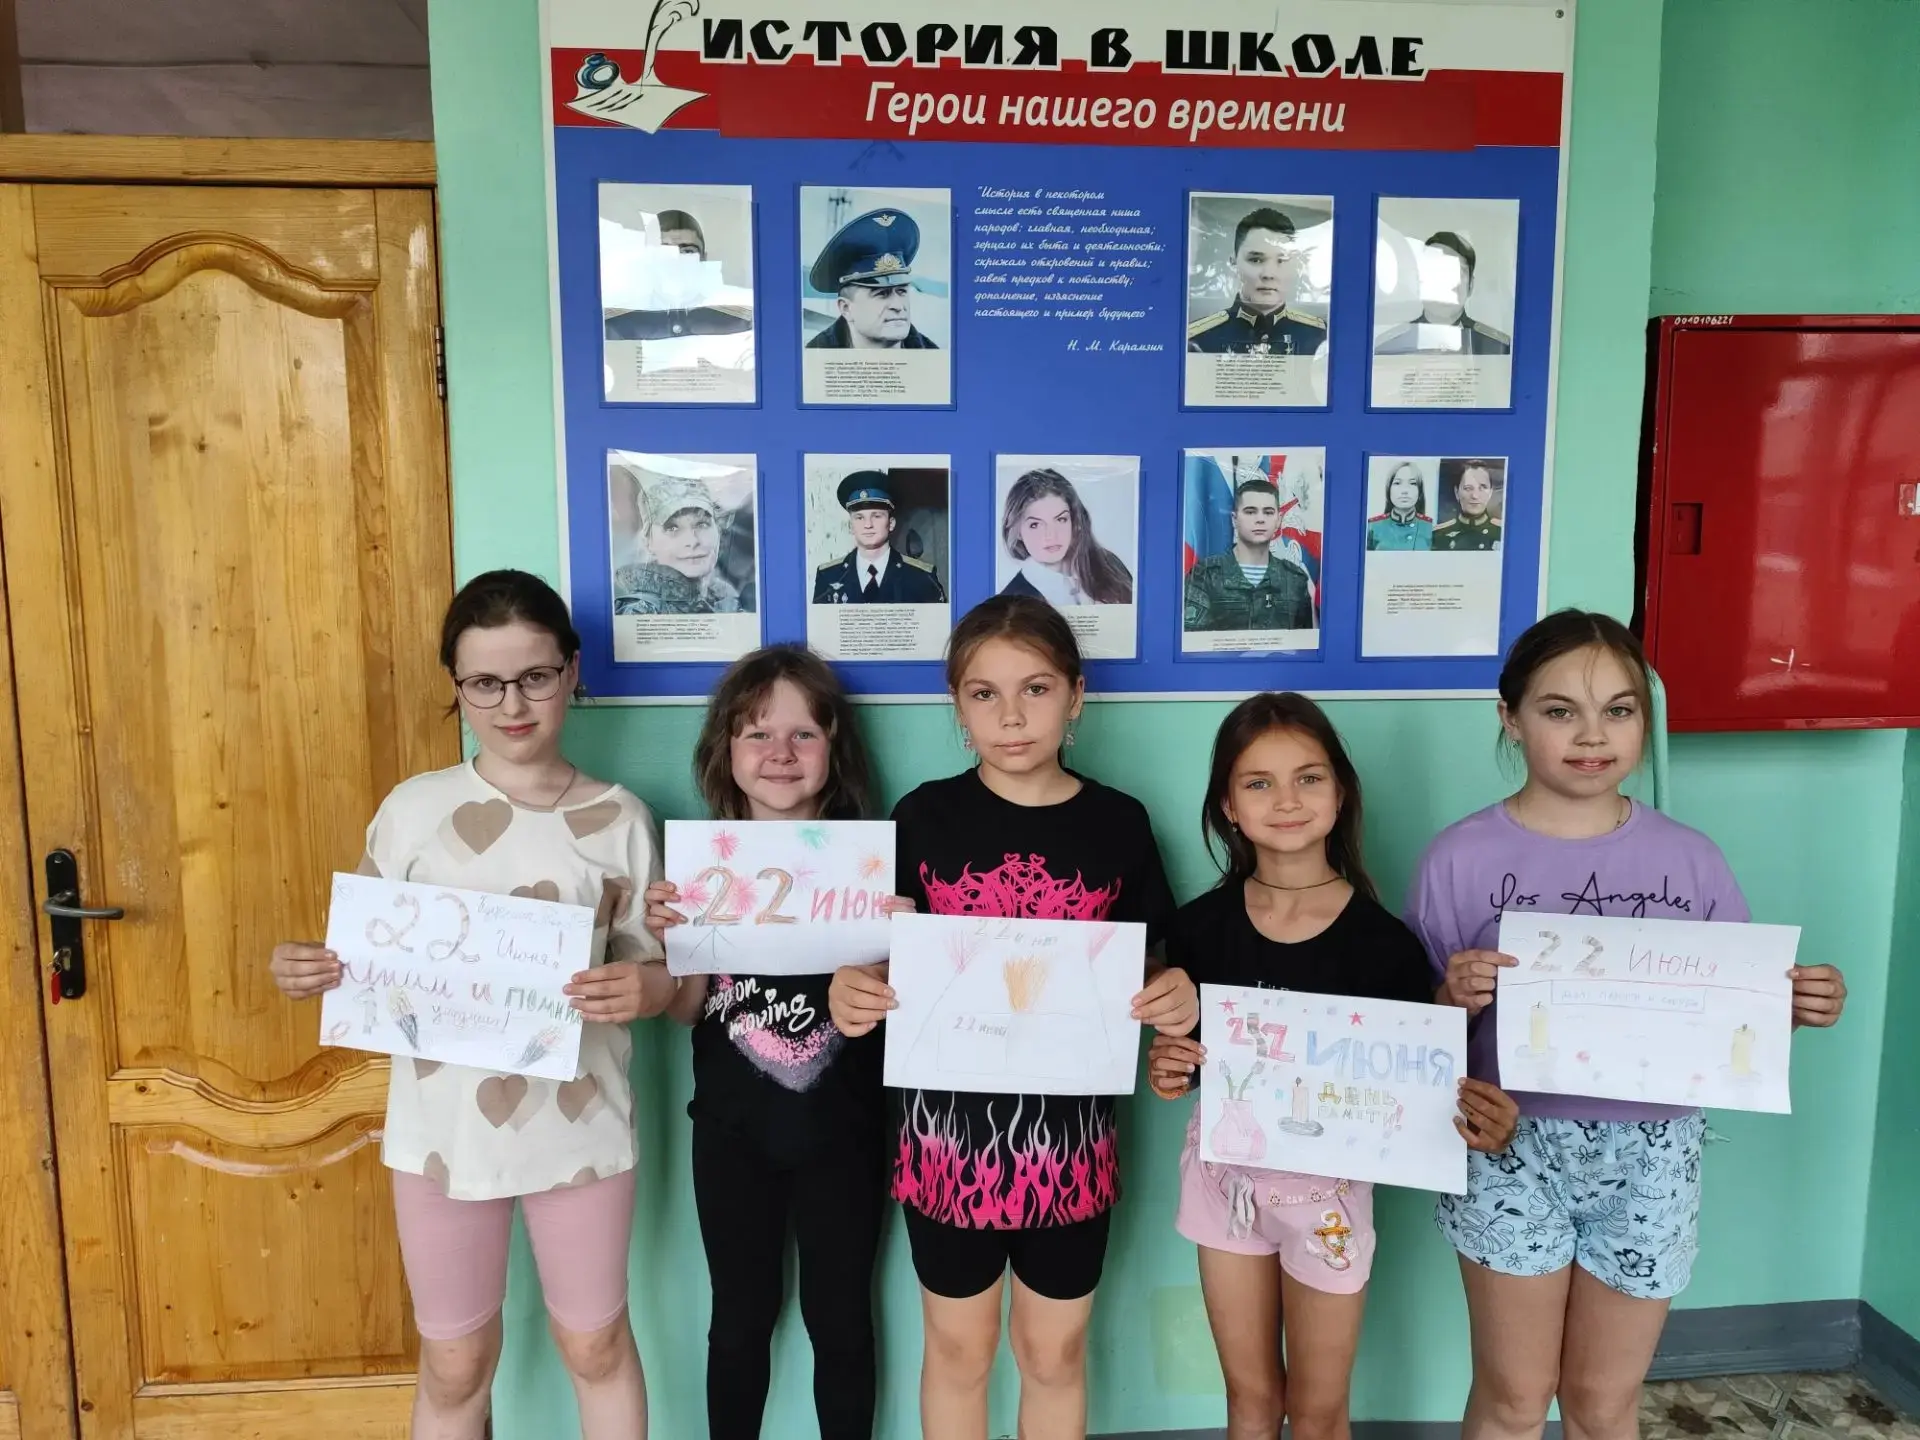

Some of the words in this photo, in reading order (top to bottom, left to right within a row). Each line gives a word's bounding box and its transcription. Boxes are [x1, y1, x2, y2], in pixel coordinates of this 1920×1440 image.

[703, 18, 1058, 67] ИСТОРИЯ
[1091, 28, 1132, 68] В
[1166, 29, 1425, 77] ШКОЛЕ
[866, 82, 986, 136] Герои
[999, 94, 1157, 129] нашего
[1168, 97, 1346, 142] времени
[977, 185, 1030, 202] "История
[1035, 188, 1041, 199] в
[1045, 190, 1104, 203] некотором
[974, 207, 1013, 216] смысле
[1017, 206, 1042, 216] есть
[1046, 206, 1107, 218] священная
[974, 240, 1017, 253] зерцало
[1021, 241, 1034, 250] их
[1038, 239, 1068, 251] быта
[974, 258, 1027, 270] скрижаль
[1031, 257, 1094, 270] откровений
[1098, 259, 1105, 268] и
[974, 273, 1007, 284] завет
[1011, 273, 1054, 286] предков
[1057, 275, 1065, 284] к
[974, 290, 1038, 304] дополнение,
[974, 307, 1040, 320] настоящего
[1043, 309, 1050, 317] и
[1055, 309, 1094, 320] пример
[1067, 339, 1080, 351] Н.
[1085, 339, 1102, 351] М.
[1109, 339, 1164, 354] Карамзин
[692, 867, 799, 927] 22
[811, 886, 892, 922] ИЮН
[1561, 872, 1691, 918] Angeles
[366, 892, 480, 963] 22
[1530, 930, 1608, 977] 22
[736, 976, 761, 1003] on
[728, 994, 815, 1041] moving
